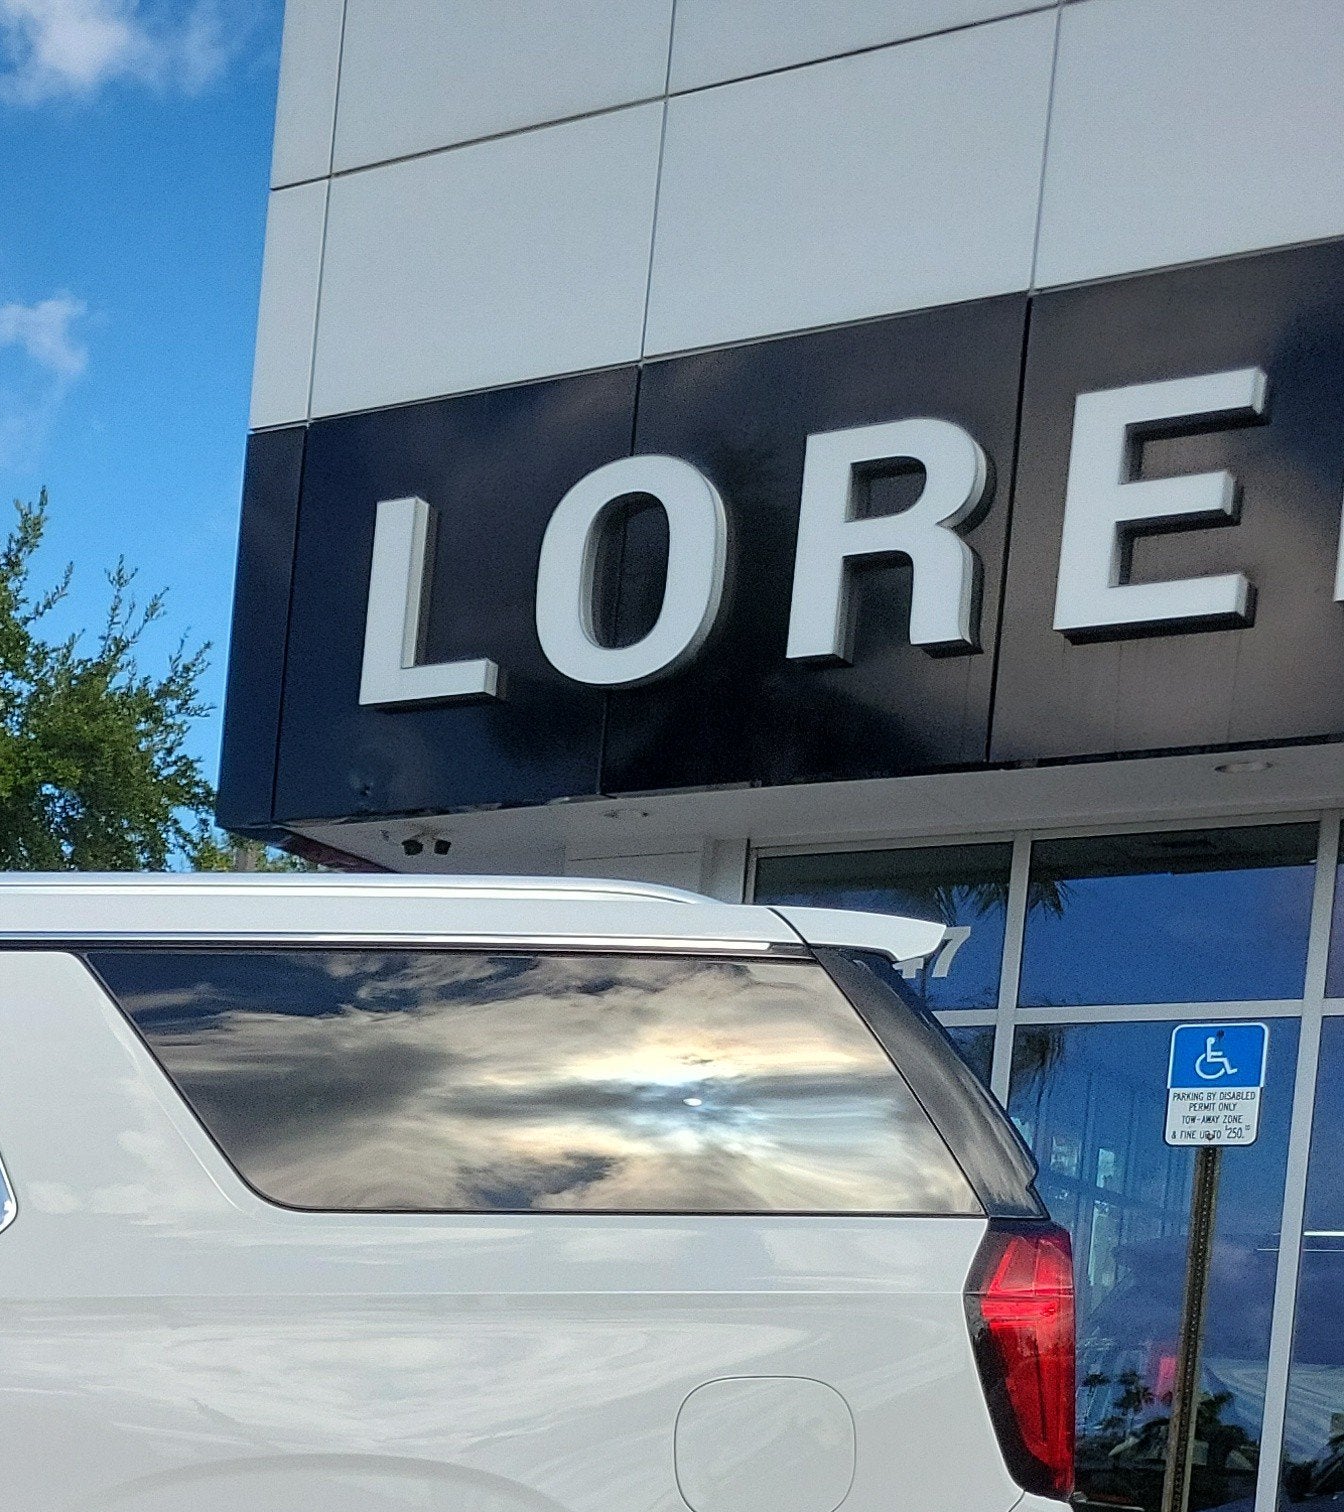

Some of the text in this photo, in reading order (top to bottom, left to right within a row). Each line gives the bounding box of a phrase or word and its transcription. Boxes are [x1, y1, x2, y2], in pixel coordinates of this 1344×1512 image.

[359, 366, 1344, 712] LORE
[1173, 1091, 1256, 1101] PARKING BY DISABLED
[1189, 1102, 1237, 1112] PERMIT ONLY
[1182, 1114, 1243, 1125] TOW-AWAY ZONE
[1179, 1130, 1196, 1139] FINE
